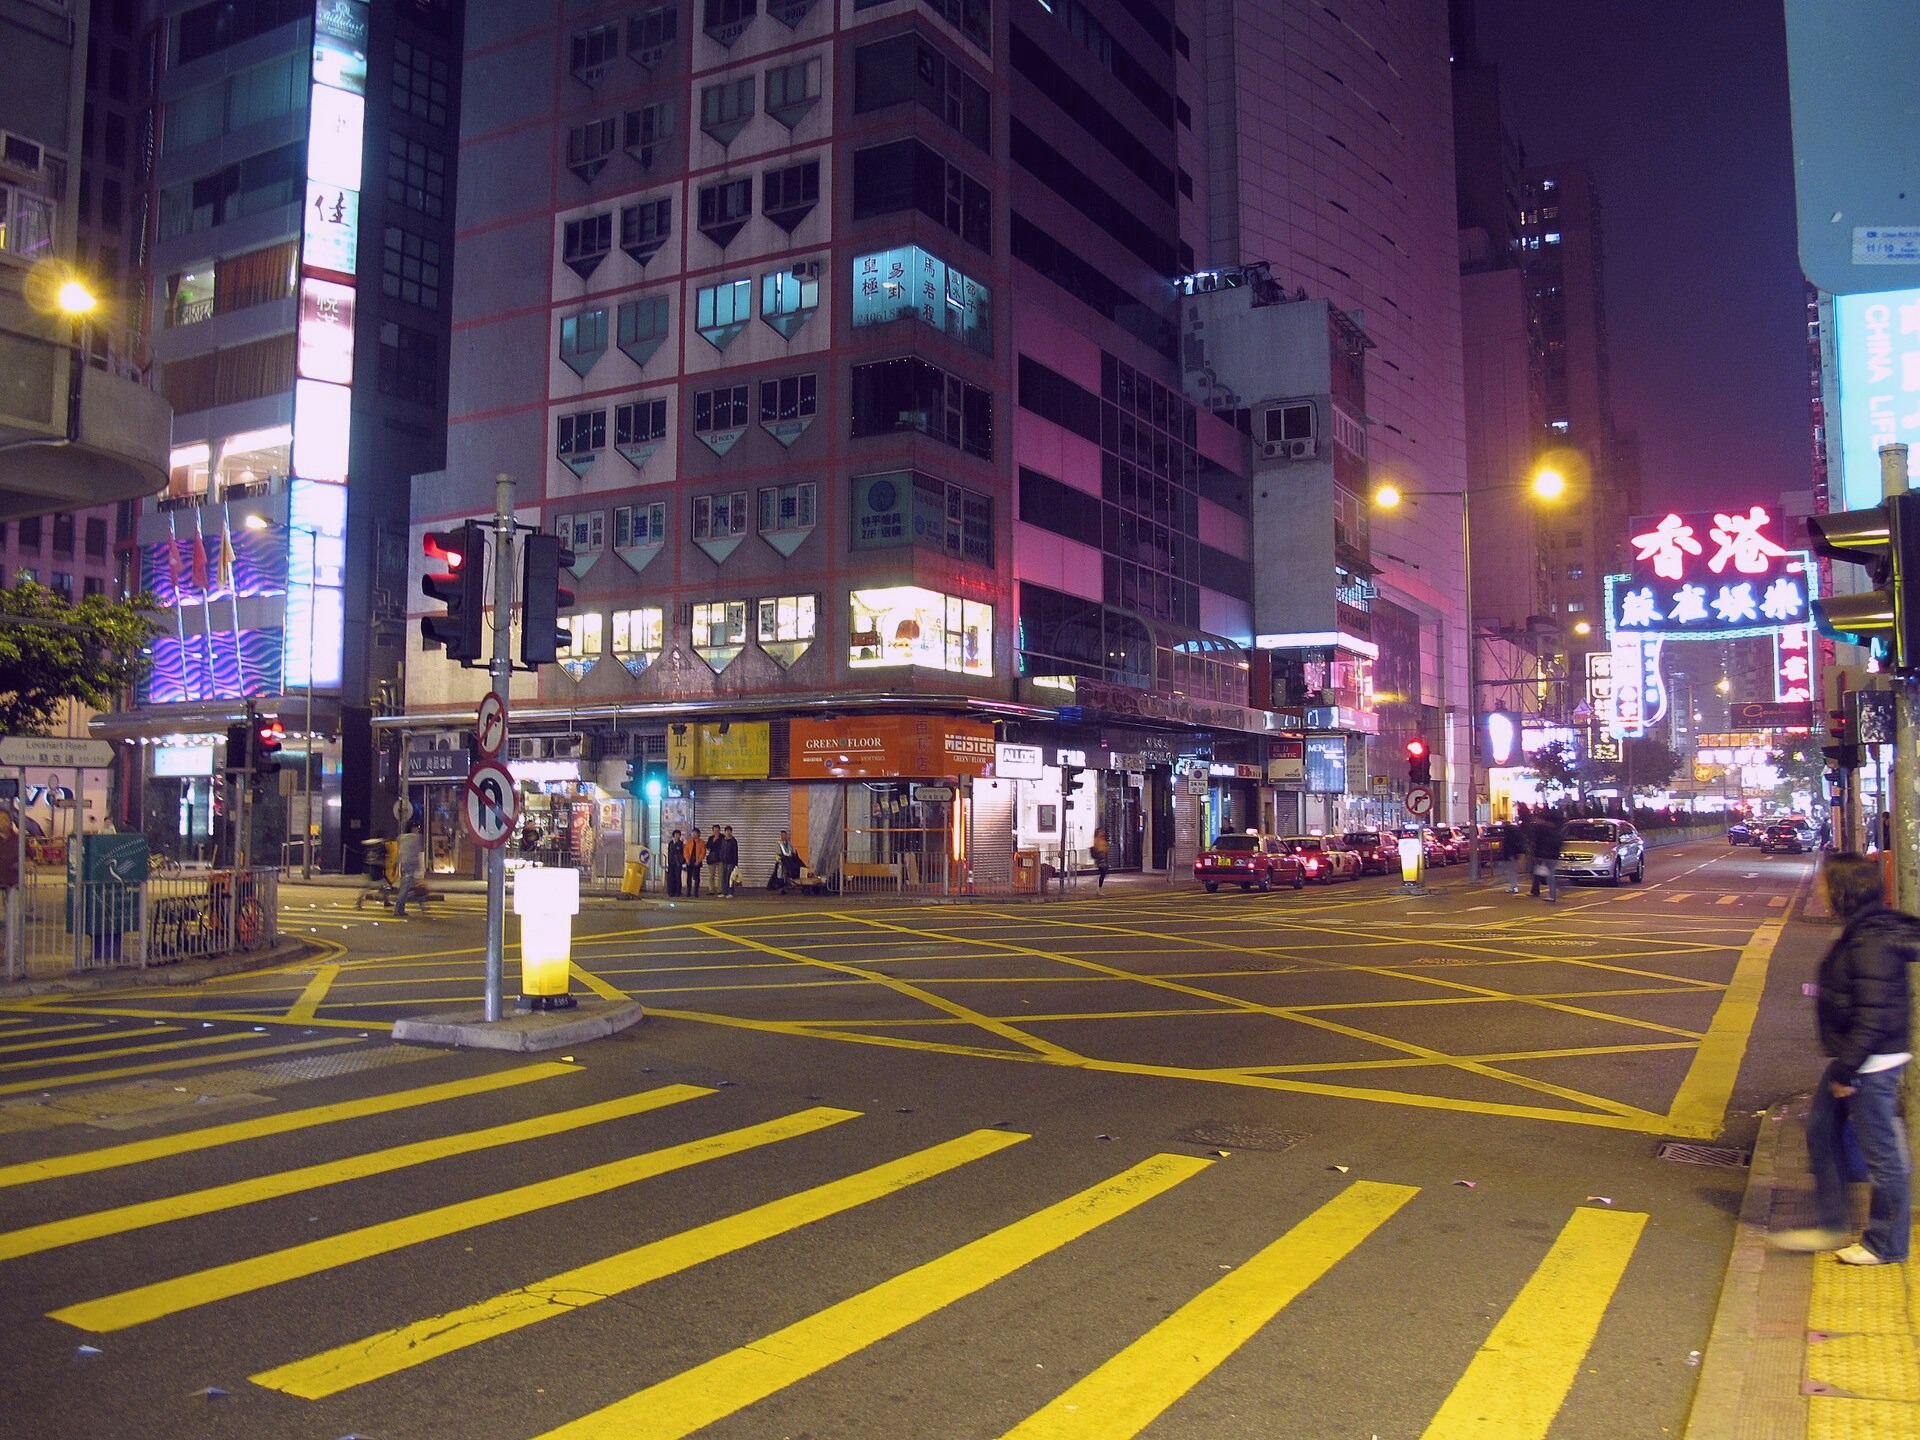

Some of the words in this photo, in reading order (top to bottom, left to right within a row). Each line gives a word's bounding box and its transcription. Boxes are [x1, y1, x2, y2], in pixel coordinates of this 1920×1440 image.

[314, 191, 351, 228] 佳
[862, 257, 879, 296] 皇極
[923, 256, 936, 325] 馬君程
[1865, 304, 1892, 384] CHINA
[1868, 395, 1896, 452] LIFE
[1631, 506, 1787, 580] 香港
[1619, 578, 1803, 627] 麻雀娛樂
[806, 739, 839, 749] GREEN
[847, 737, 882, 748] FLOOR
